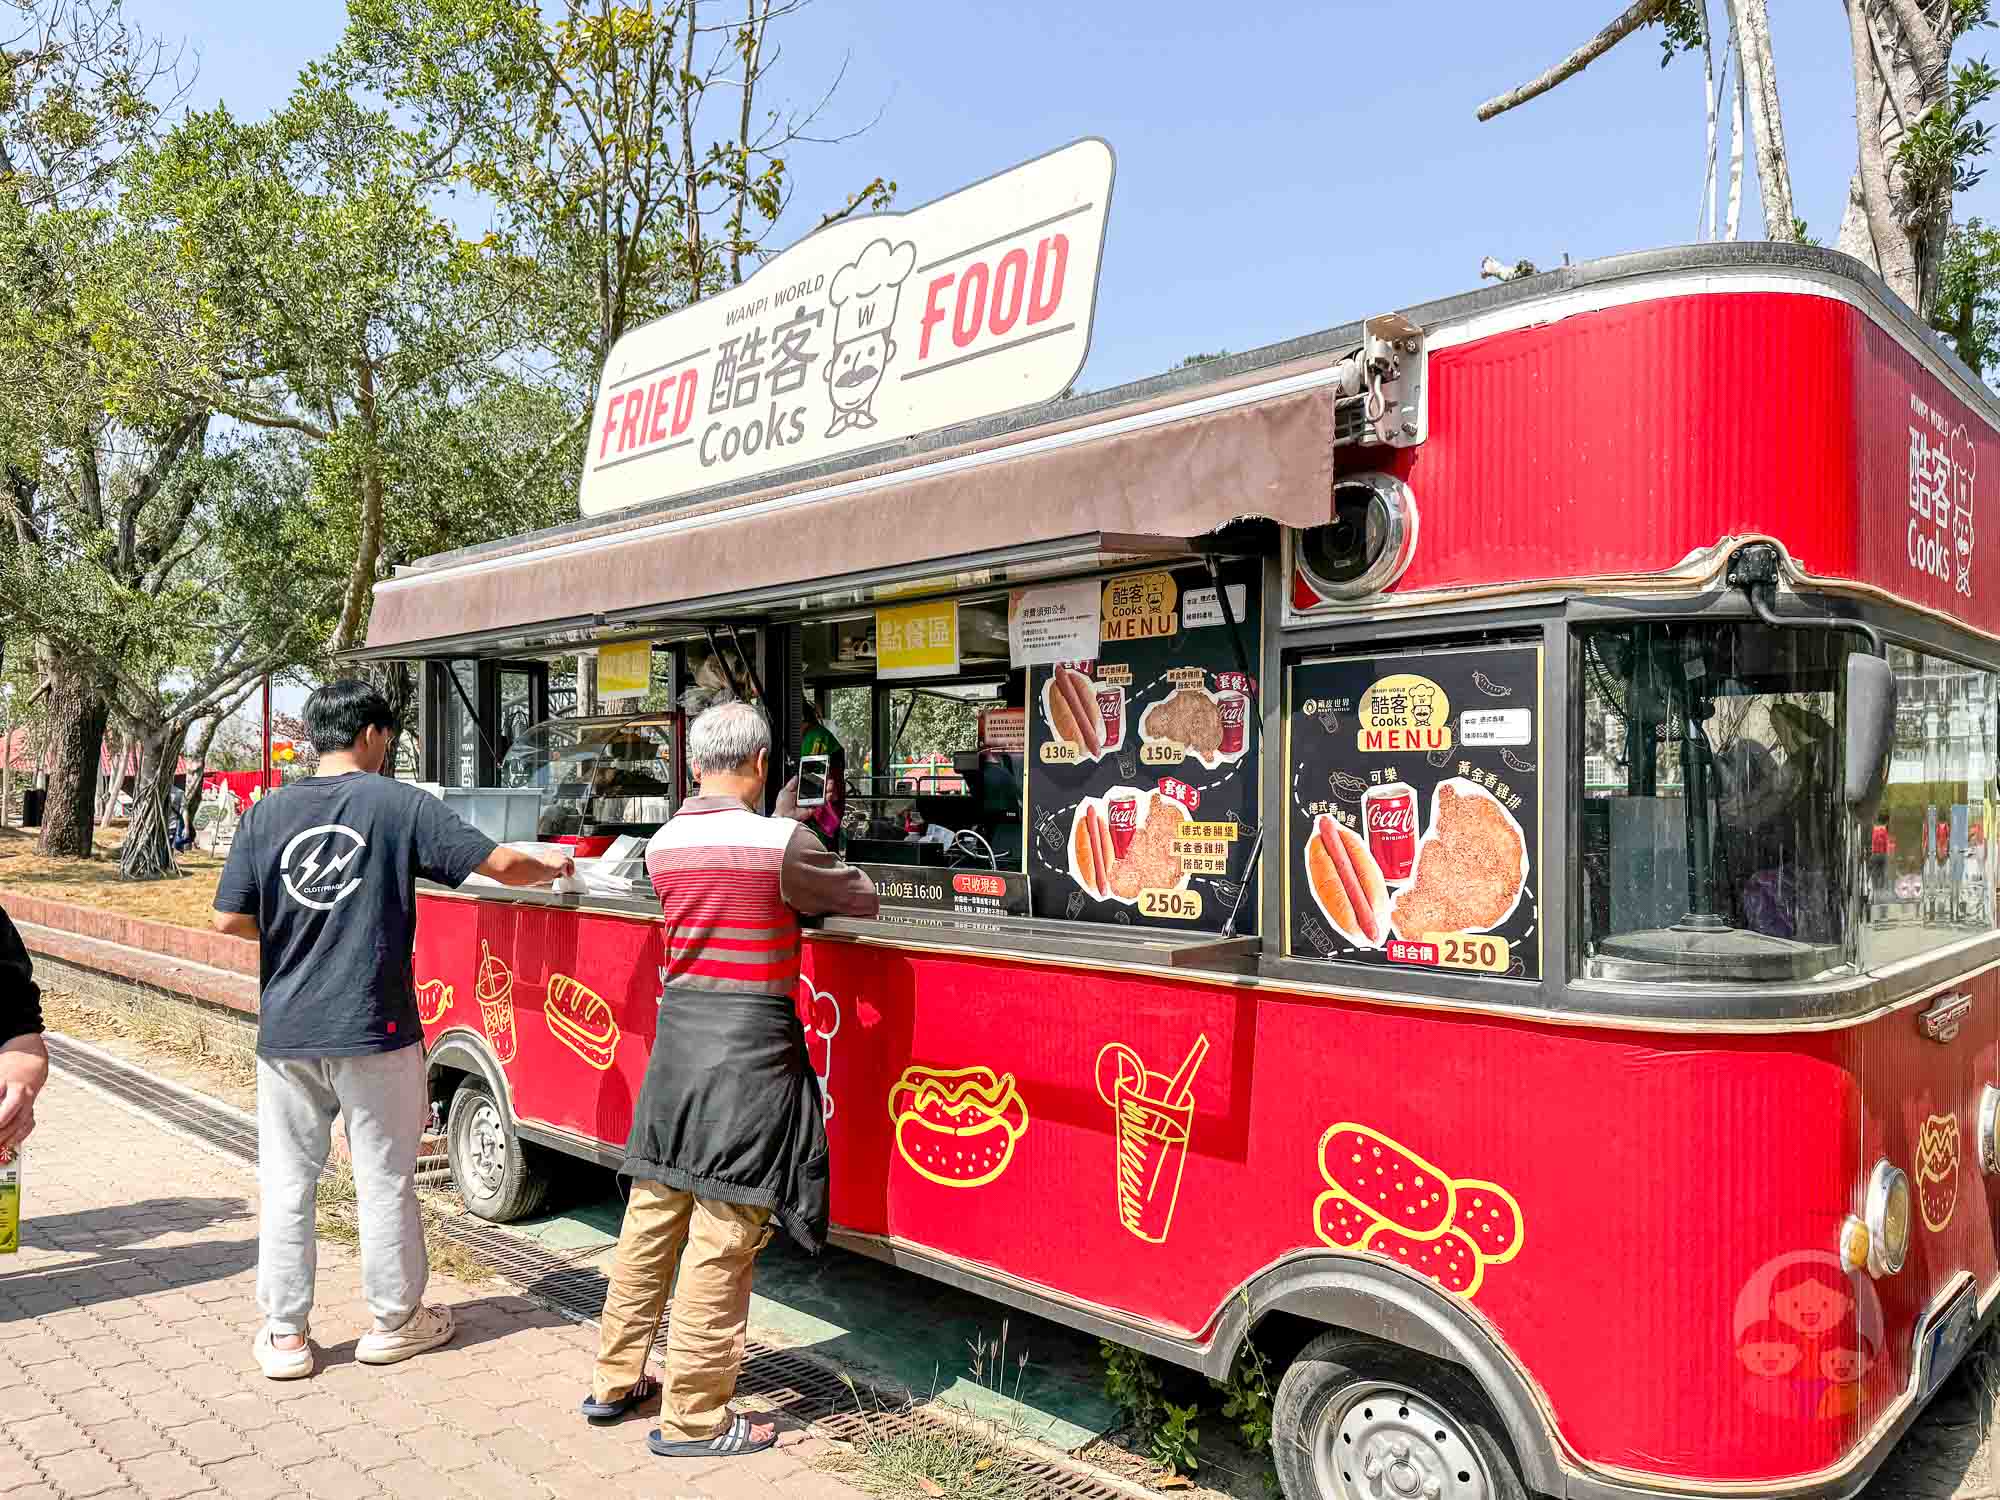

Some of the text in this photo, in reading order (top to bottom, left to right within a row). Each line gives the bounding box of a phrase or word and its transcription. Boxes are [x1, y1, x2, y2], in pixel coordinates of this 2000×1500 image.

[726, 273, 825, 327] WANPI WORLD
[918, 233, 1069, 361] FOOD
[858, 302, 876, 329] W
[706, 304, 825, 416] 酷客
[599, 366, 699, 460] FRIED
[1930, 407, 1950, 438] WORLD
[699, 402, 806, 468] Cooks
[1908, 424, 1951, 529] 酷客
[1907, 517, 1950, 583] Cooks
[1111, 583, 1144, 606] 酷客
[1112, 605, 1143, 618] Cooks
[1107, 614, 1171, 640] MENU
[1371, 693, 1409, 715] 酷客
[1371, 715, 1408, 727] Cooks
[1365, 727, 1443, 750] MENU
[1044, 745, 1075, 760] 130元
[1146, 745, 1182, 761] 150元
[1369, 766, 1398, 785] 可樂
[1457, 760, 1523, 811] 黃金香雞排
[1164, 779, 1198, 806] 套餐3
[1183, 858, 1225, 871] 搭配可樂
[874, 881, 943, 901] 11:00至16:00
[1145, 893, 1196, 917] 250元
[1392, 943, 1433, 961] 組合價
[1444, 939, 1497, 967] 250
